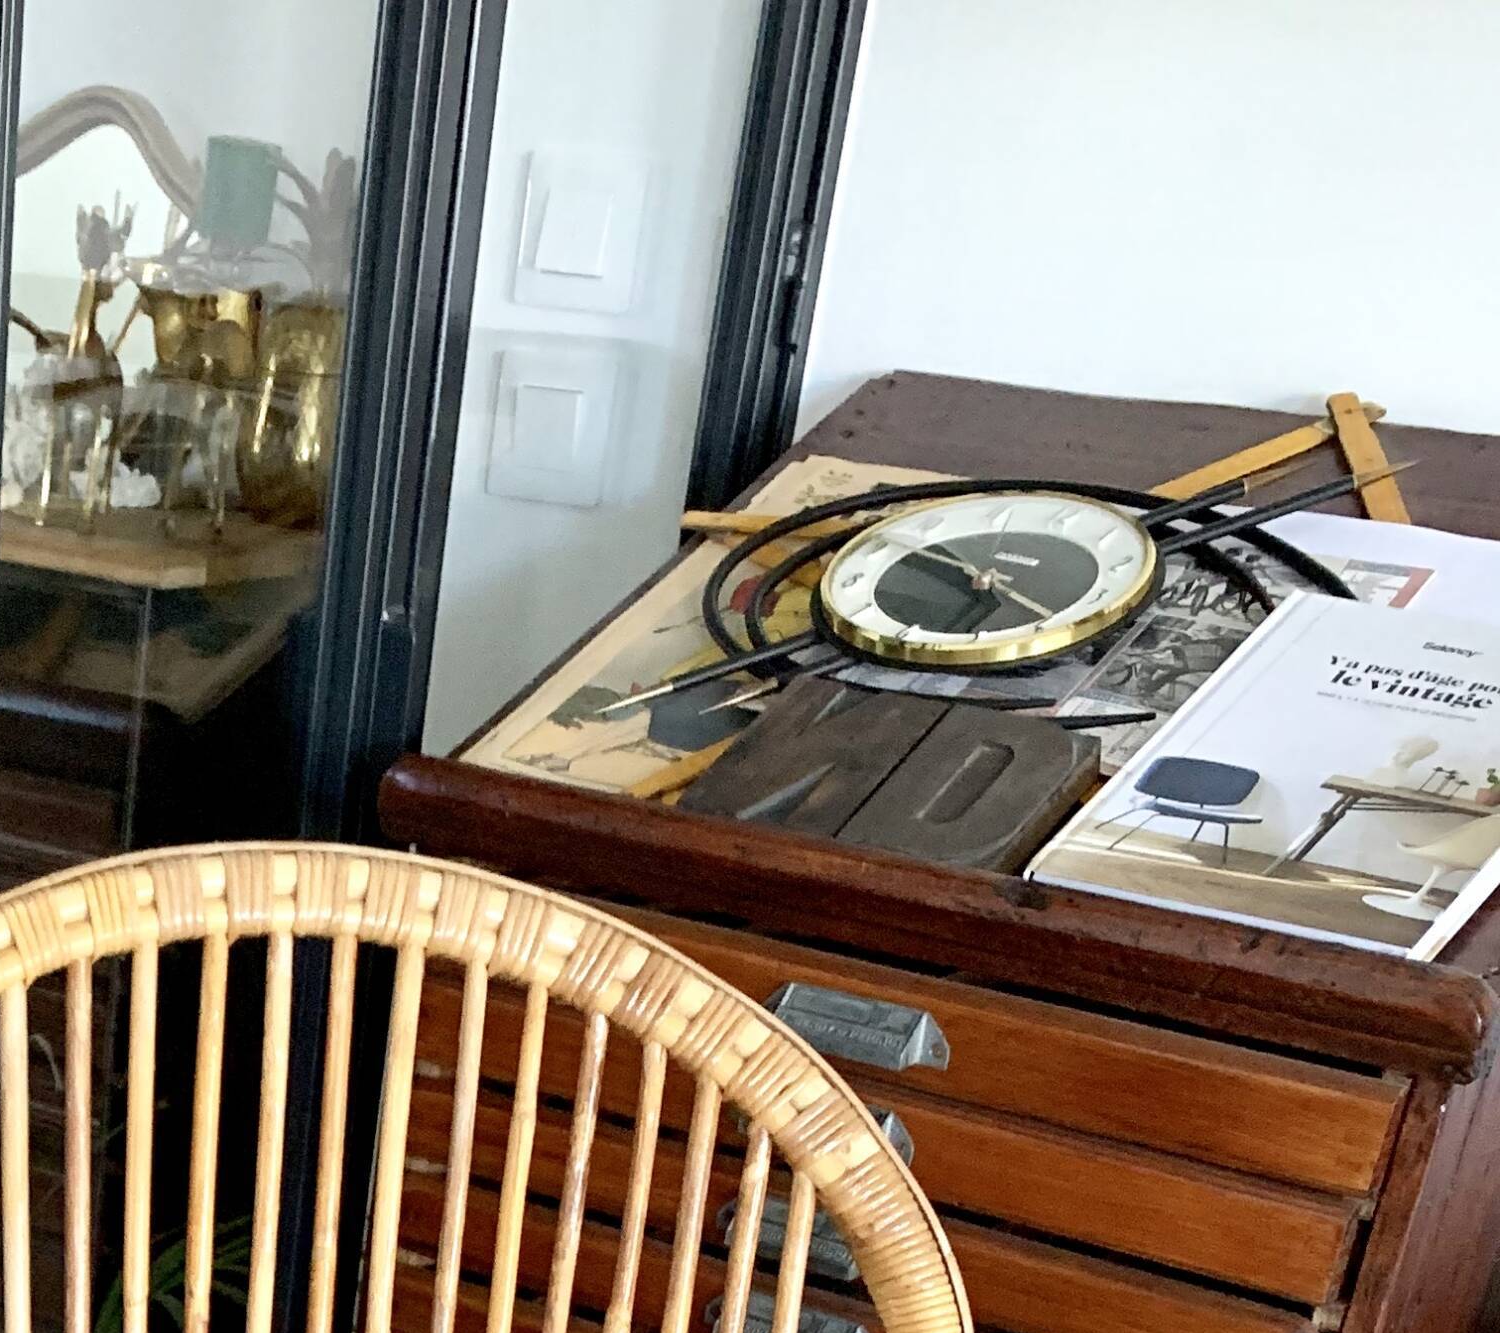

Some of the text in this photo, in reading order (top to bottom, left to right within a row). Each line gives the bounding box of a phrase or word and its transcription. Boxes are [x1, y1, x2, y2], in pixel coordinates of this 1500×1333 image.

[1363, 663, 1404, 677] pas
[1330, 669, 1361, 687] le
[1370, 679, 1493, 709] vintage
